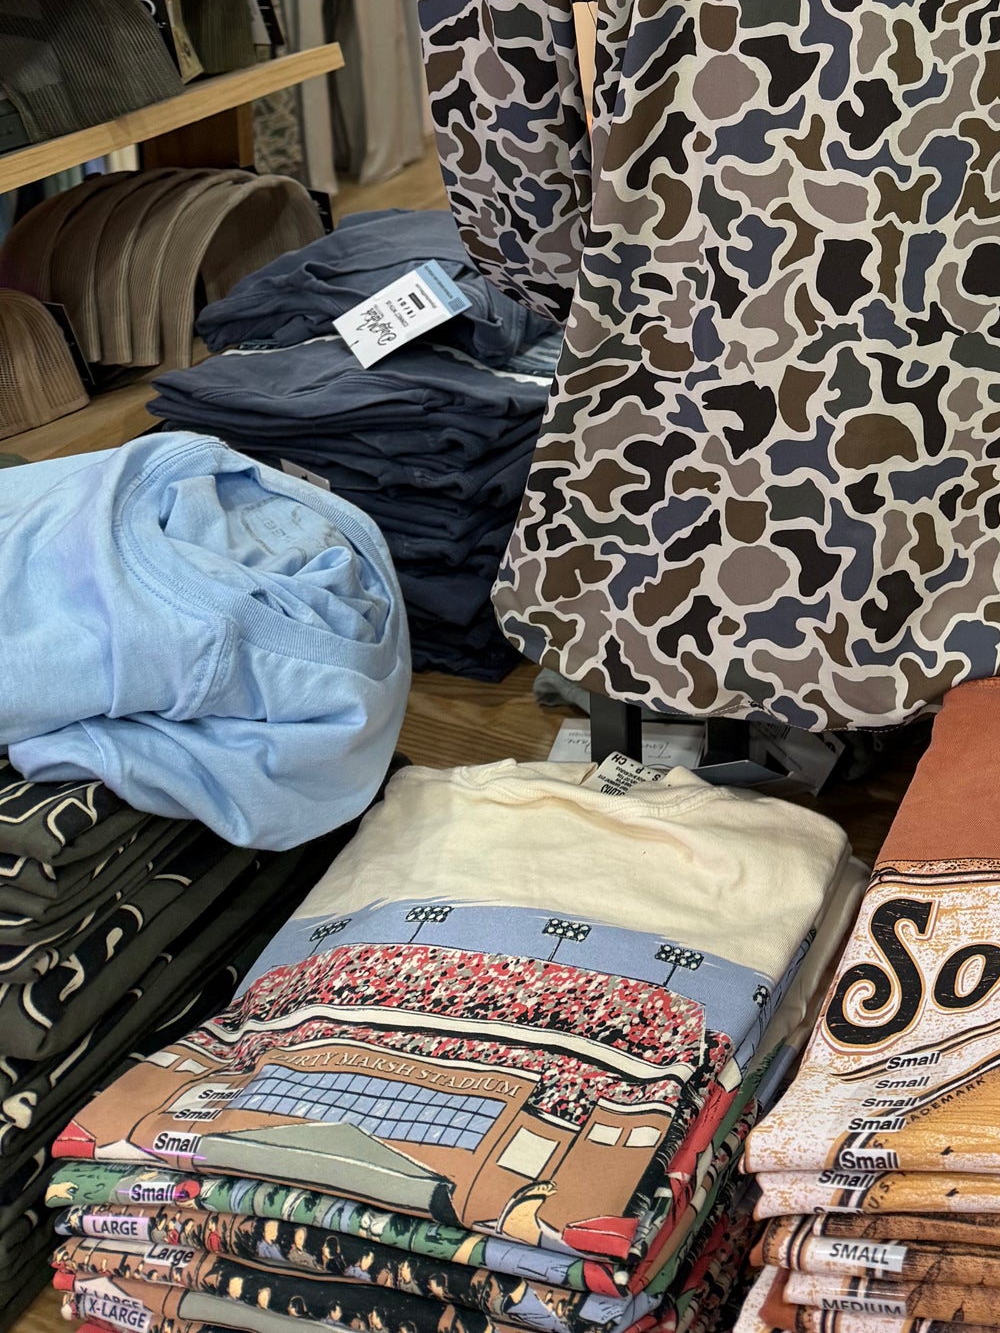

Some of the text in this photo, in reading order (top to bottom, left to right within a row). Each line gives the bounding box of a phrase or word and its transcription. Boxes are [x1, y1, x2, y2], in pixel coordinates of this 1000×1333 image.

[611, 753, 627, 765] CH
[887, 1052, 940, 1069] Small
[337, 1053, 415, 1077] MARSH
[416, 1071, 521, 1098] STADIUM
[875, 1076, 930, 1089] Small
[198, 1089, 244, 1100] Small
[862, 1097, 918, 1107] Small
[906, 1077, 986, 1124] ADEMARK
[174, 1109, 221, 1120] Small
[848, 1118, 905, 1130] Small
[154, 1132, 201, 1154] Small
[841, 1151, 898, 1169] Small
[818, 1170, 874, 1188] Small
[130, 1183, 175, 1201] Small
[93, 1220, 139, 1236] LARGE
[147, 1244, 195, 1266] Large
[829, 1243, 889, 1265] SMALL
[89, 1297, 147, 1332] X-LARGE
[822, 1298, 901, 1315] MEDIUM
